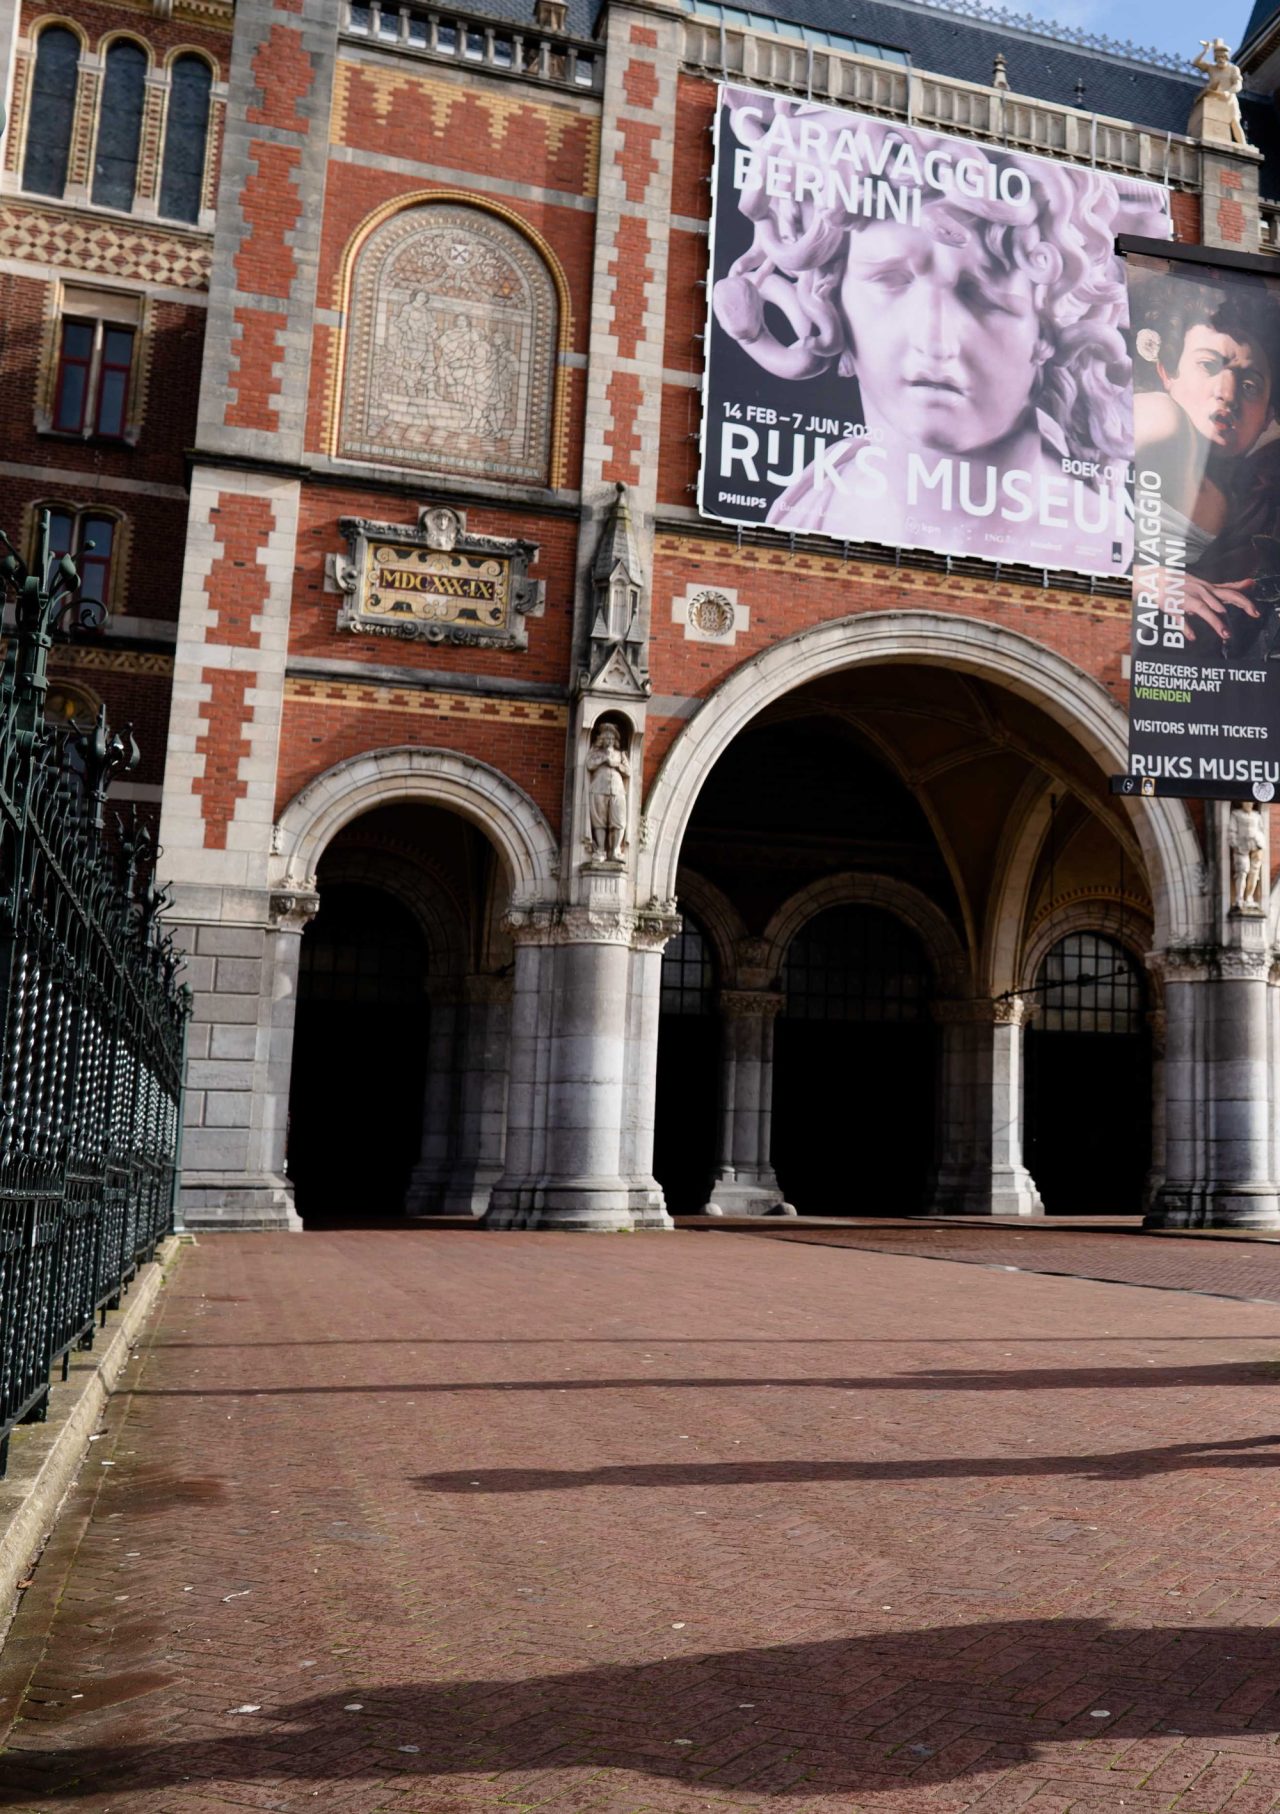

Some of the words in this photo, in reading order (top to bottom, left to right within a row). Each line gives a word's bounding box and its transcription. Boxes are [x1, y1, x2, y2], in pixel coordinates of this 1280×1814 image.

[734, 106, 1032, 207] CARAVAGGIO
[733, 148, 921, 227] BERNINI
[723, 402, 742, 419] 14
[805, 416, 839, 435] JUN
[1062, 458, 1100, 478] BOEK
[718, 491, 767, 509] PHILIPS
[1136, 470, 1162, 647] CARAVAGGIO
[1163, 539, 1187, 649] BERNINI
[1135, 660, 1198, 679] BEZOEKERS
[1201, 667, 1225, 681] MET
[1228, 669, 1267, 683] TICKET
[1134, 674, 1222, 693] MUSEUMKAART
[1134, 686, 1191, 703] VRIENDEN
[1133, 719, 1185, 735] VISITORS
[1187, 723, 1219, 737] WITH
[1221, 724, 1268, 739] TICKETS
